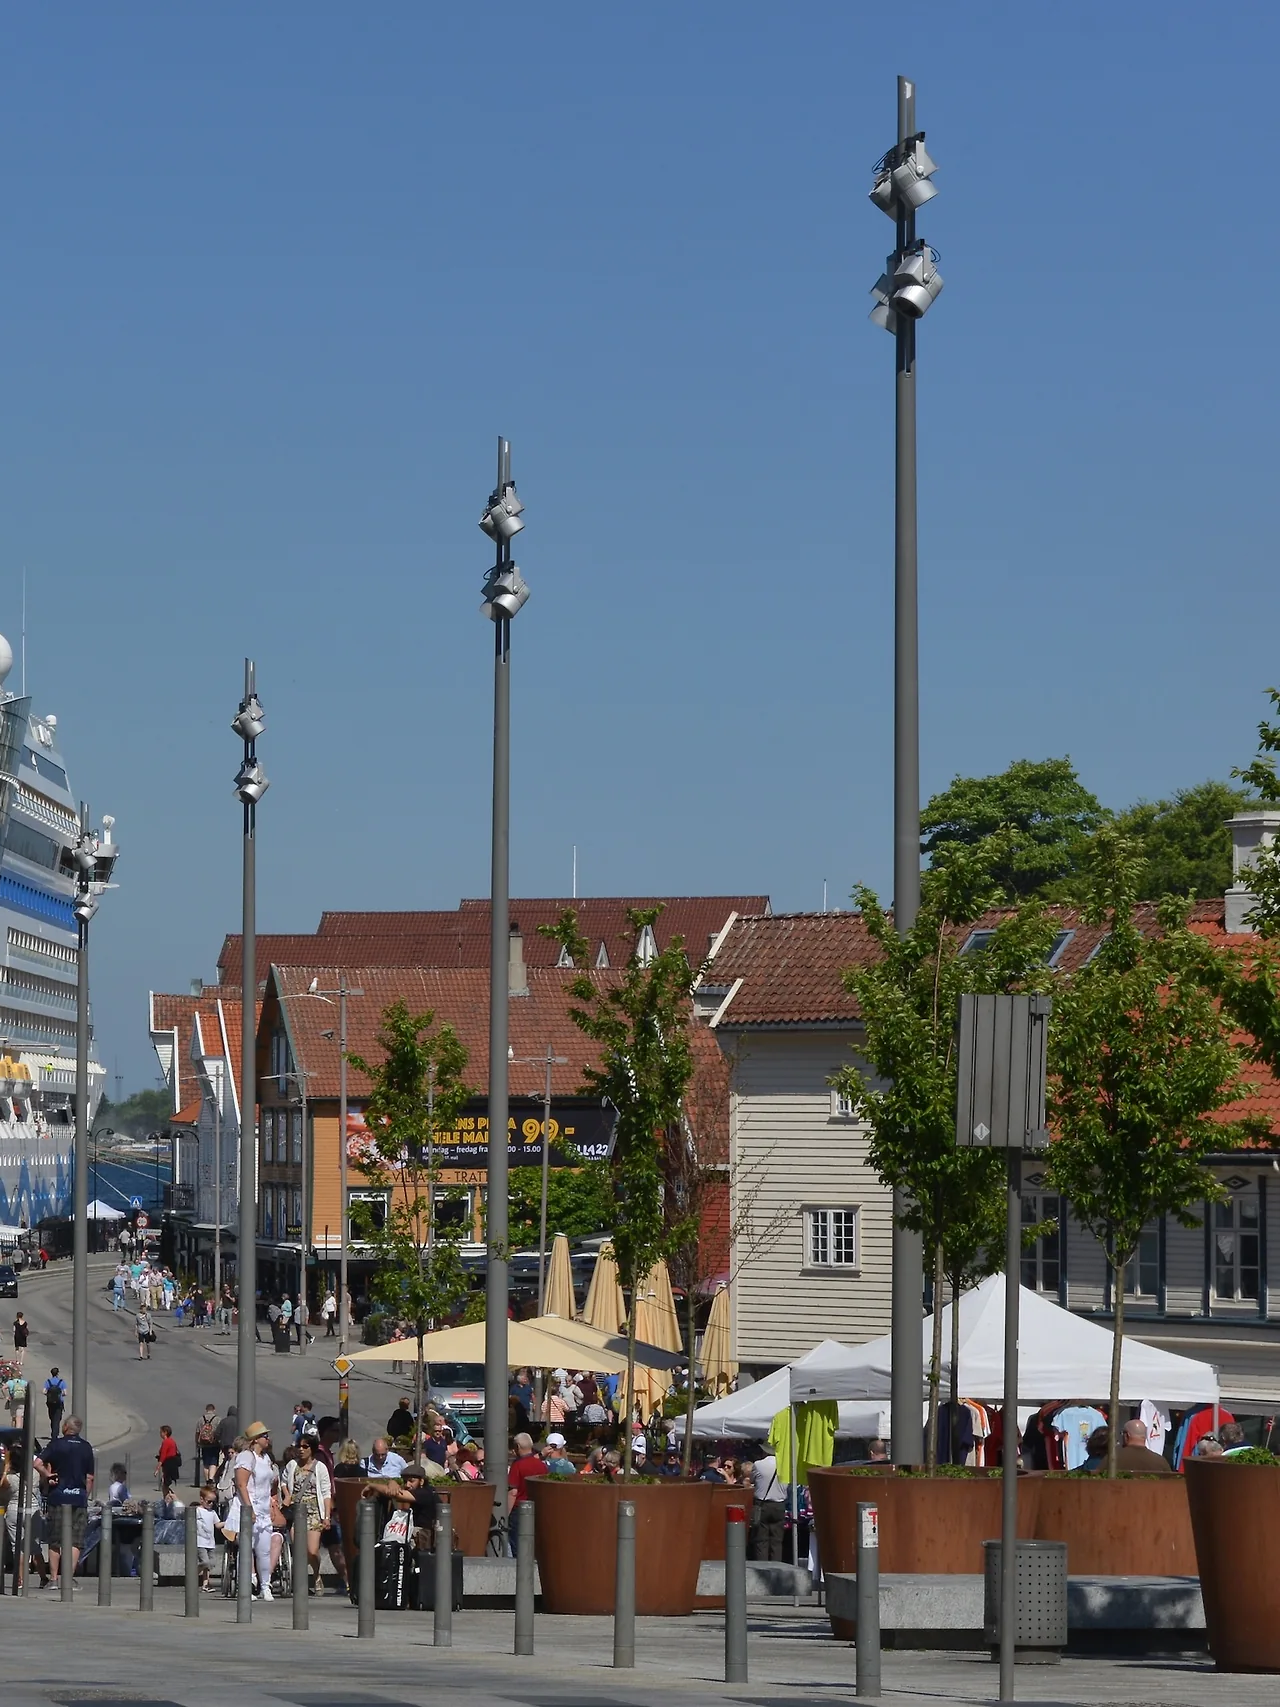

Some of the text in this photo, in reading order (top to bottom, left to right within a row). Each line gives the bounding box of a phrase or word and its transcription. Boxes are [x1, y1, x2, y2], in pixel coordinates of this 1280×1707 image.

[477, 1117, 517, 1130] PIA
[422, 1145, 449, 1154] Mndag
[456, 1145, 477, 1155] fredag
[478, 1145, 489, 1153] fra
